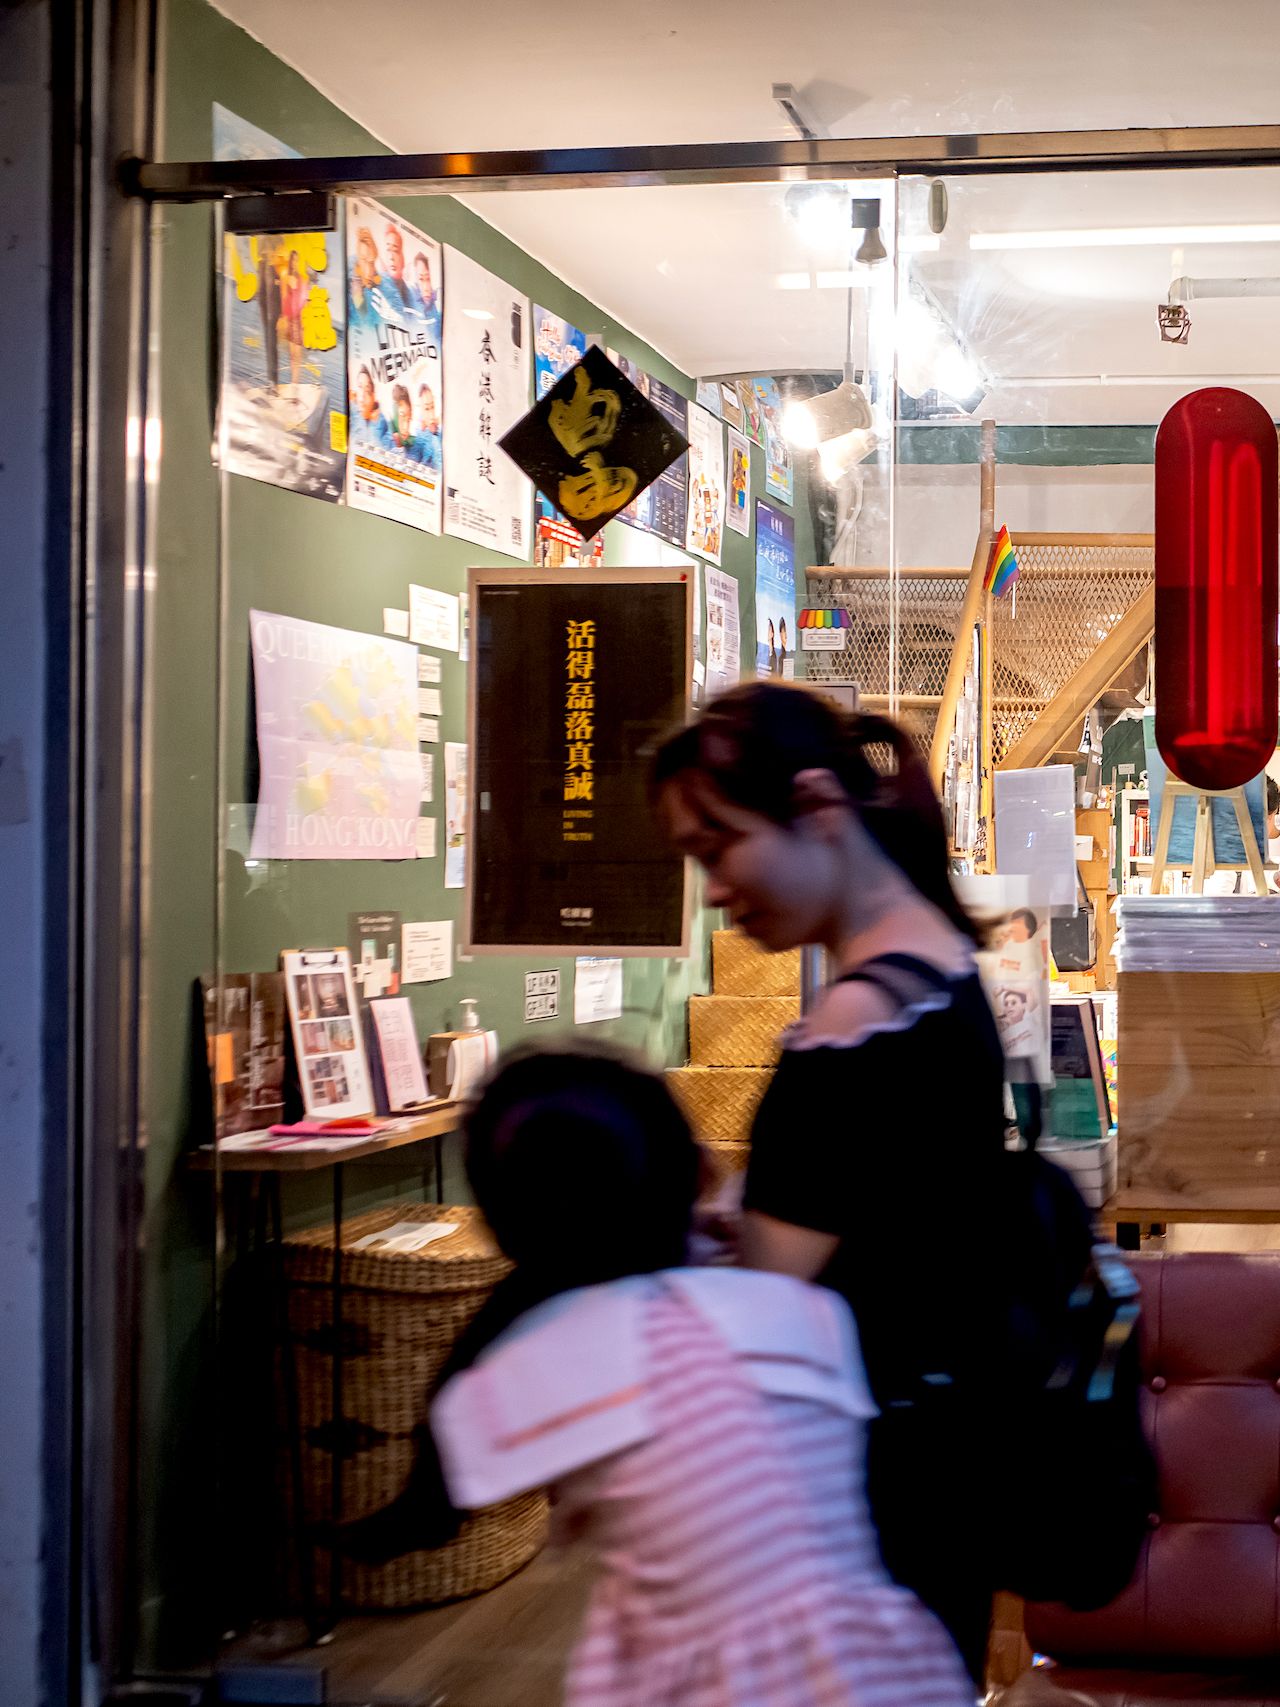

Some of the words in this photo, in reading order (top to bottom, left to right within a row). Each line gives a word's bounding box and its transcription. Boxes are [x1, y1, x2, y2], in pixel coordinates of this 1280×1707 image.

[376, 322, 426, 351] LITTLE
[370, 344, 438, 383] MERMAID
[563, 619, 596, 801] 活得磊落真誠
[285, 813, 354, 847] HONG
[357, 813, 417, 848] KONG
